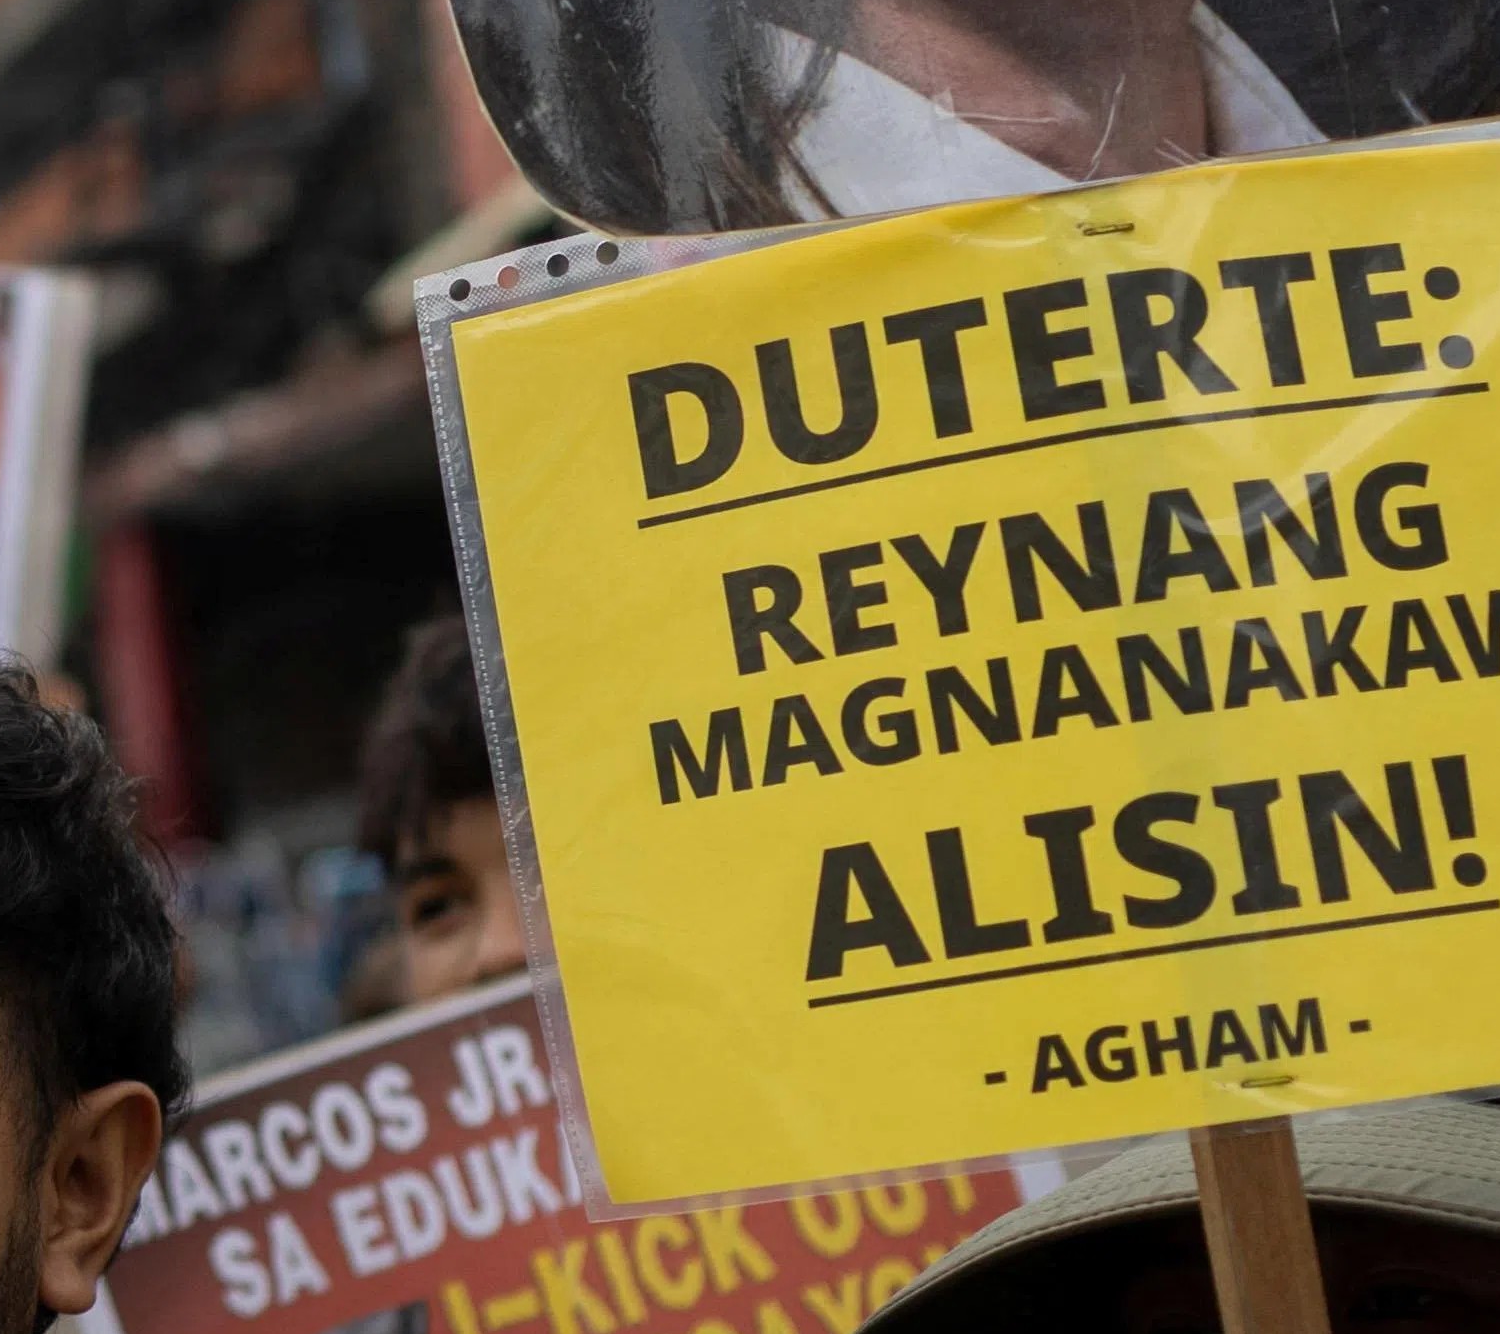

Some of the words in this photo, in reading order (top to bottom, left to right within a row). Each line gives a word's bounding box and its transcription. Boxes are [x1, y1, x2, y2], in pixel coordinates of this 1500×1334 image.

[626, 242, 1476, 501] DUTERTE:
[721, 461, 1450, 677] REYNANG
[804, 753, 1489, 984] ALISIN!
[1030, 997, 1327, 1094] AGHAM
[207, 1210, 332, 1319] SA
